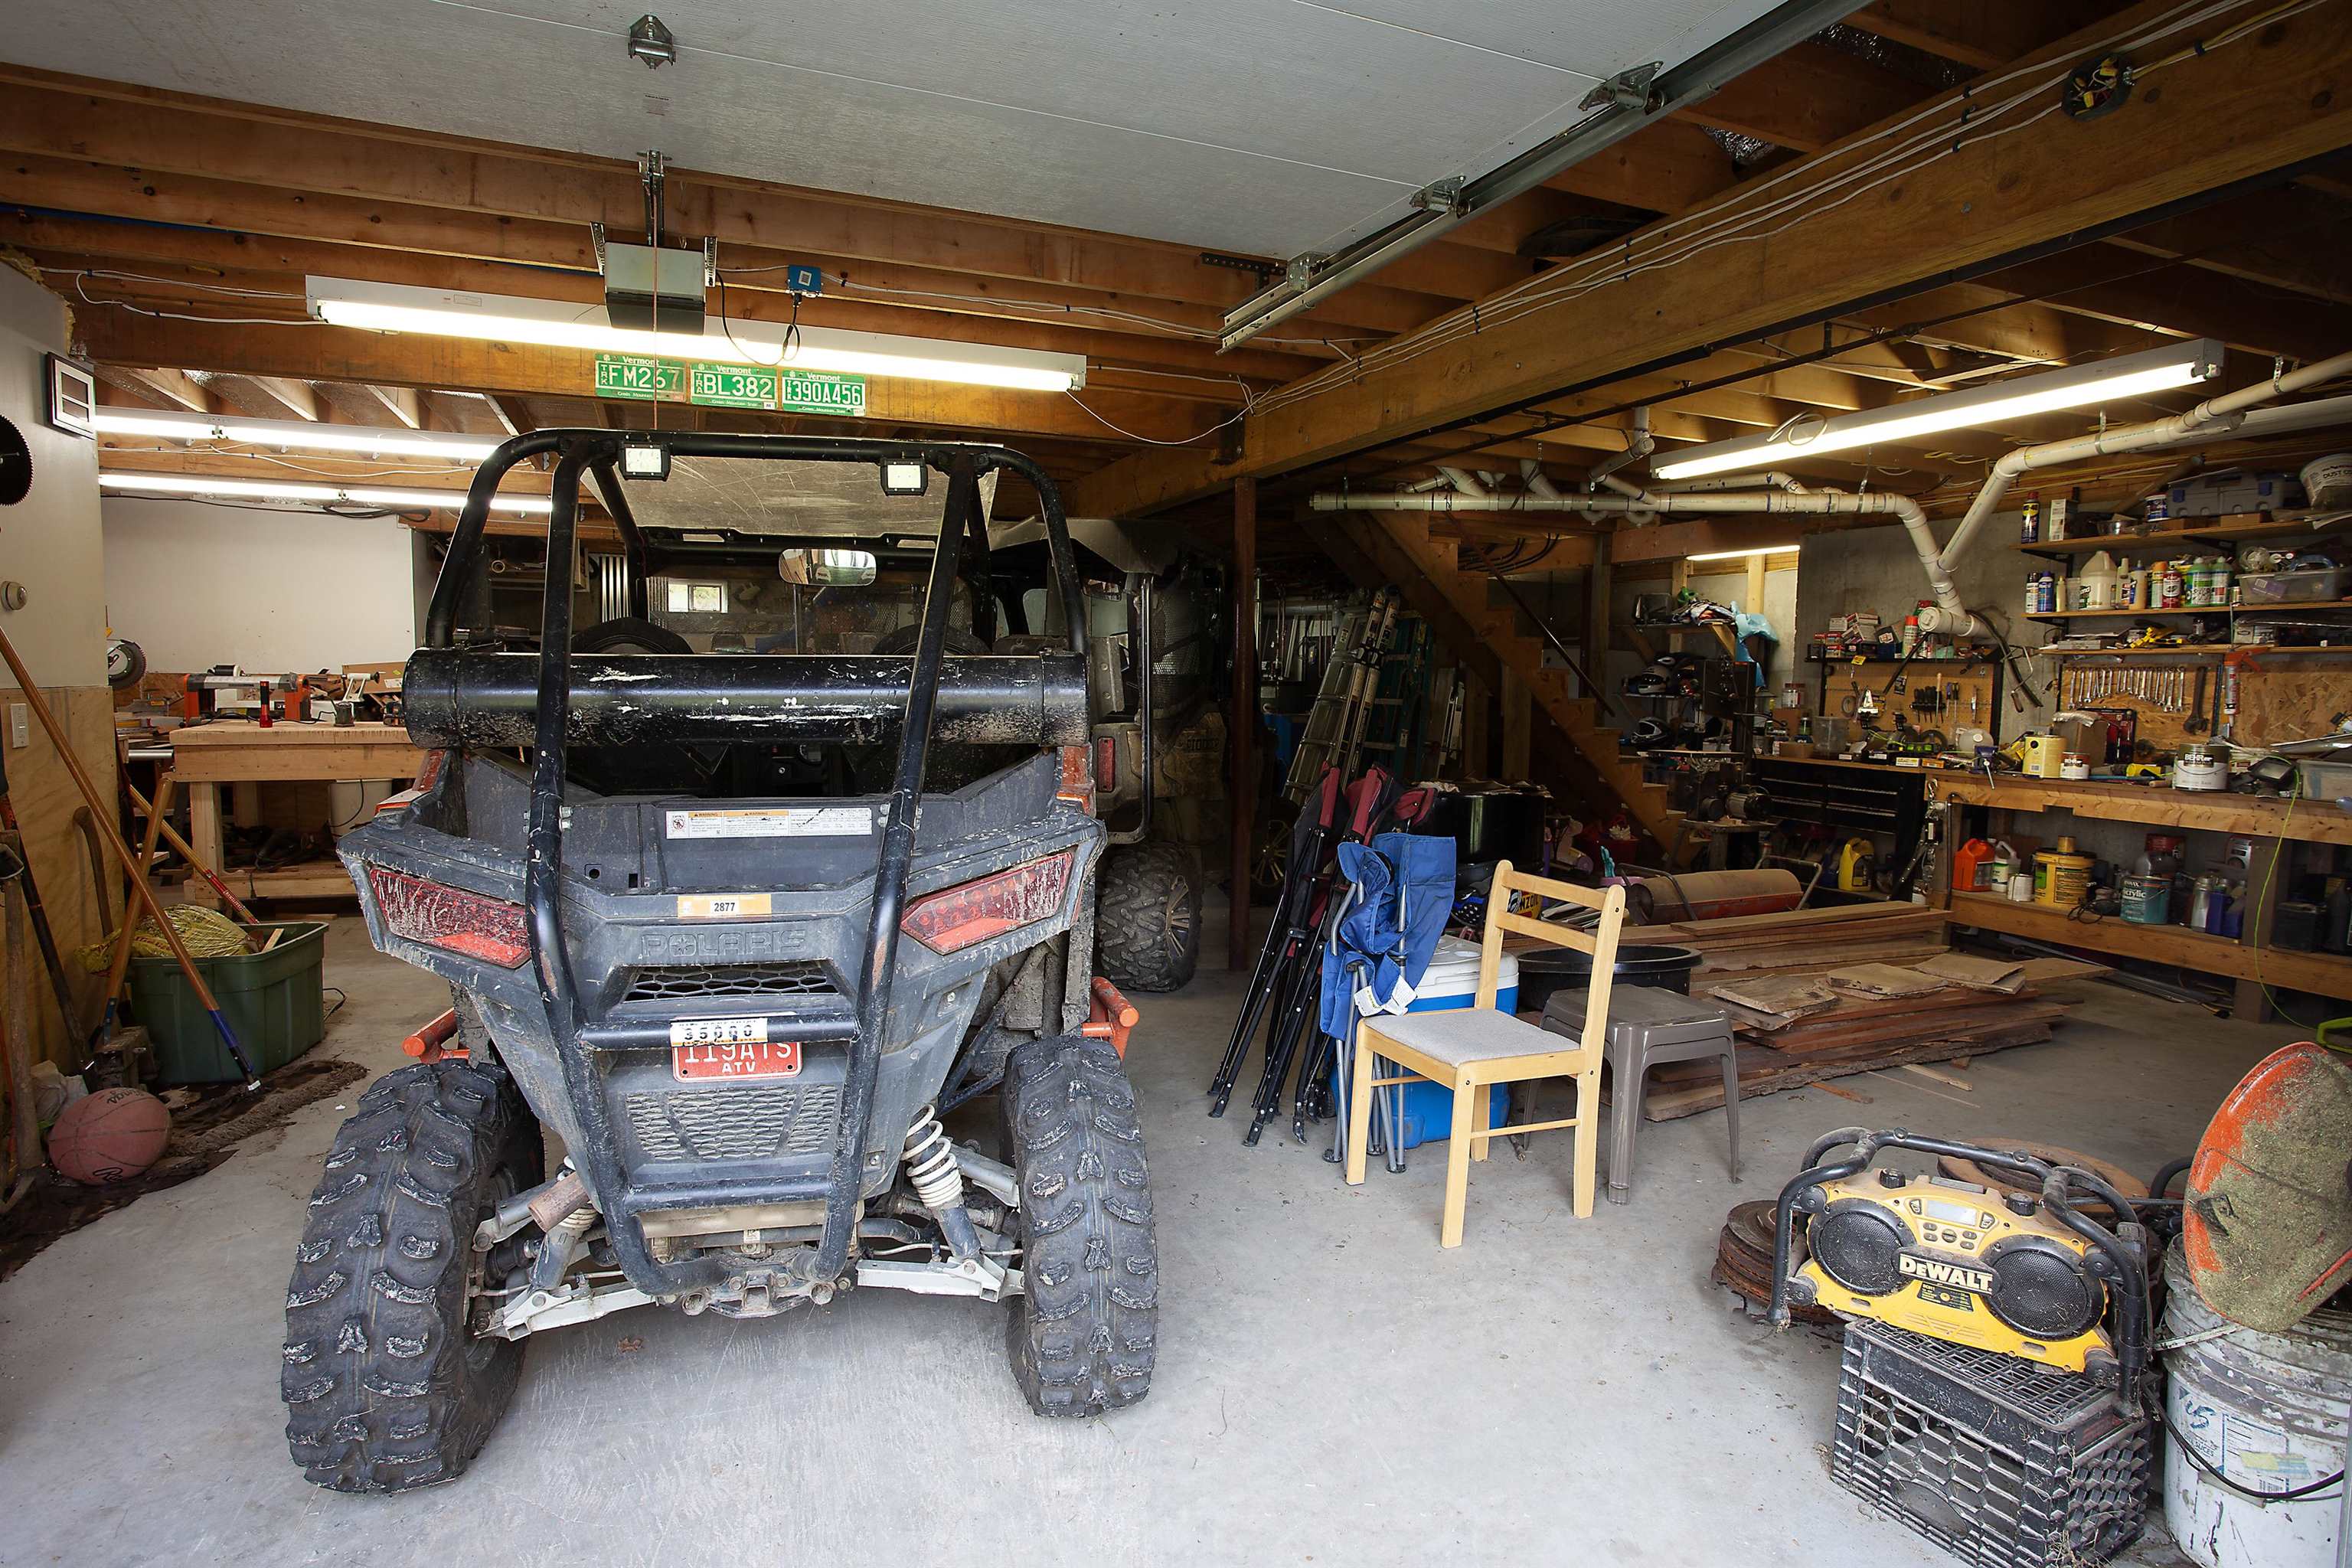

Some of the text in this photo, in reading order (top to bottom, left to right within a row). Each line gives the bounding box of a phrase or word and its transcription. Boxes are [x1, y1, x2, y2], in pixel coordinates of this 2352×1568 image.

[716, 365, 752, 374] Vermont
[806, 373, 841, 381] Vermont
[704, 374, 772, 398] BL382
[792, 381, 861, 405] 390A456
[714, 902, 736, 912] 2877
[641, 928, 805, 957] POLARIS
[722, 1061, 756, 1073] ATV
